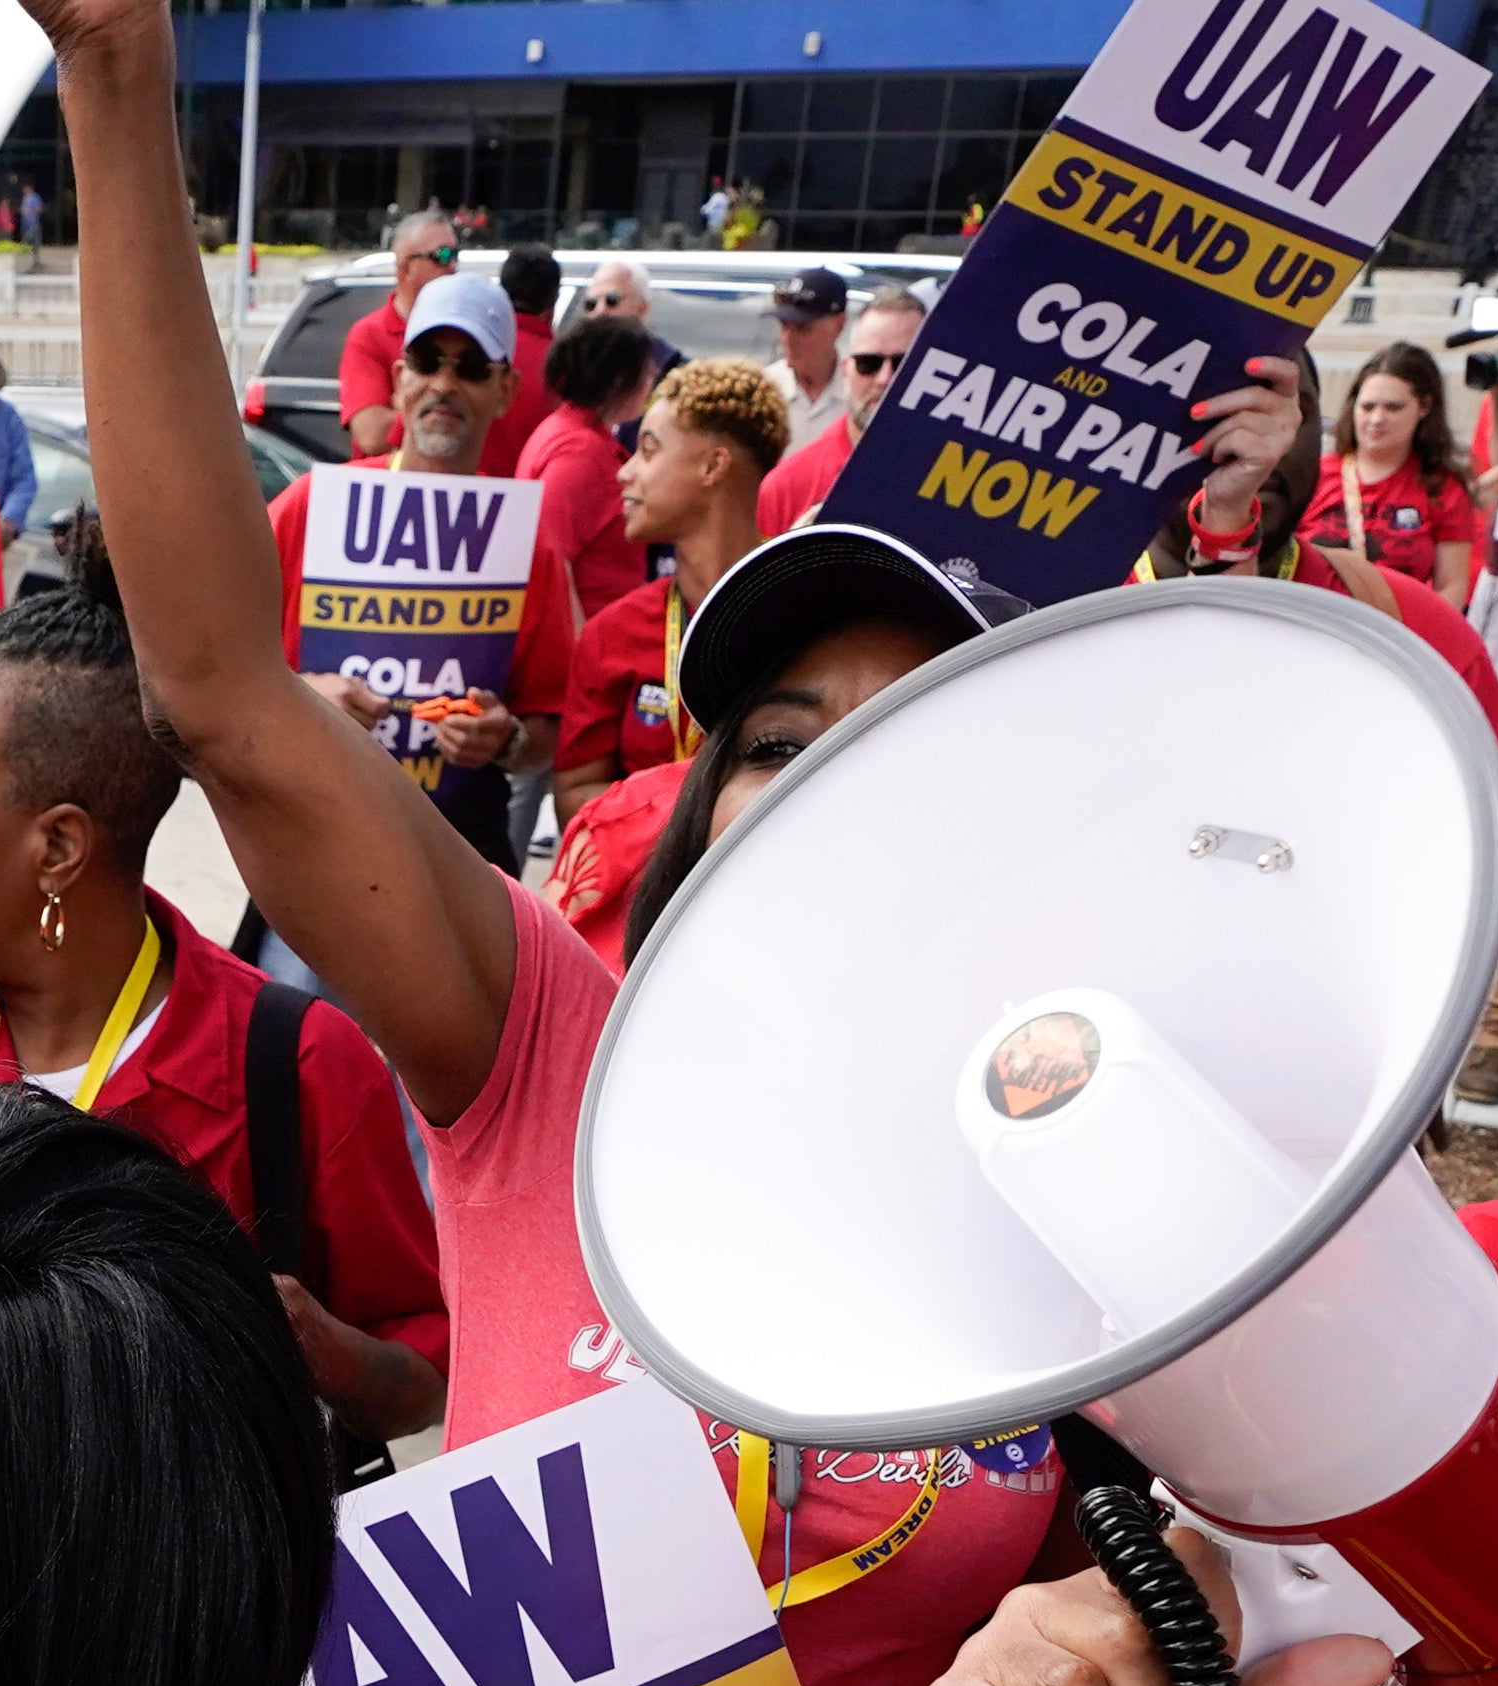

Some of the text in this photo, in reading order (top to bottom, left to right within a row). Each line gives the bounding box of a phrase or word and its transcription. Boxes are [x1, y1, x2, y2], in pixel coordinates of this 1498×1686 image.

[1154, 0, 1435, 207] UAW
[1038, 156, 1337, 311] STAND UP
[1016, 282, 1212, 400] COLA
[1053, 367, 1110, 397] AND
[899, 347, 1202, 493] FAIR PAY
[344, 482, 506, 574] UAW
[918, 439, 1101, 540] NOW
[313, 590, 510, 629] STAND UP
[340, 654, 466, 697] COLA
[852, 1495, 935, 1572] DREAM
